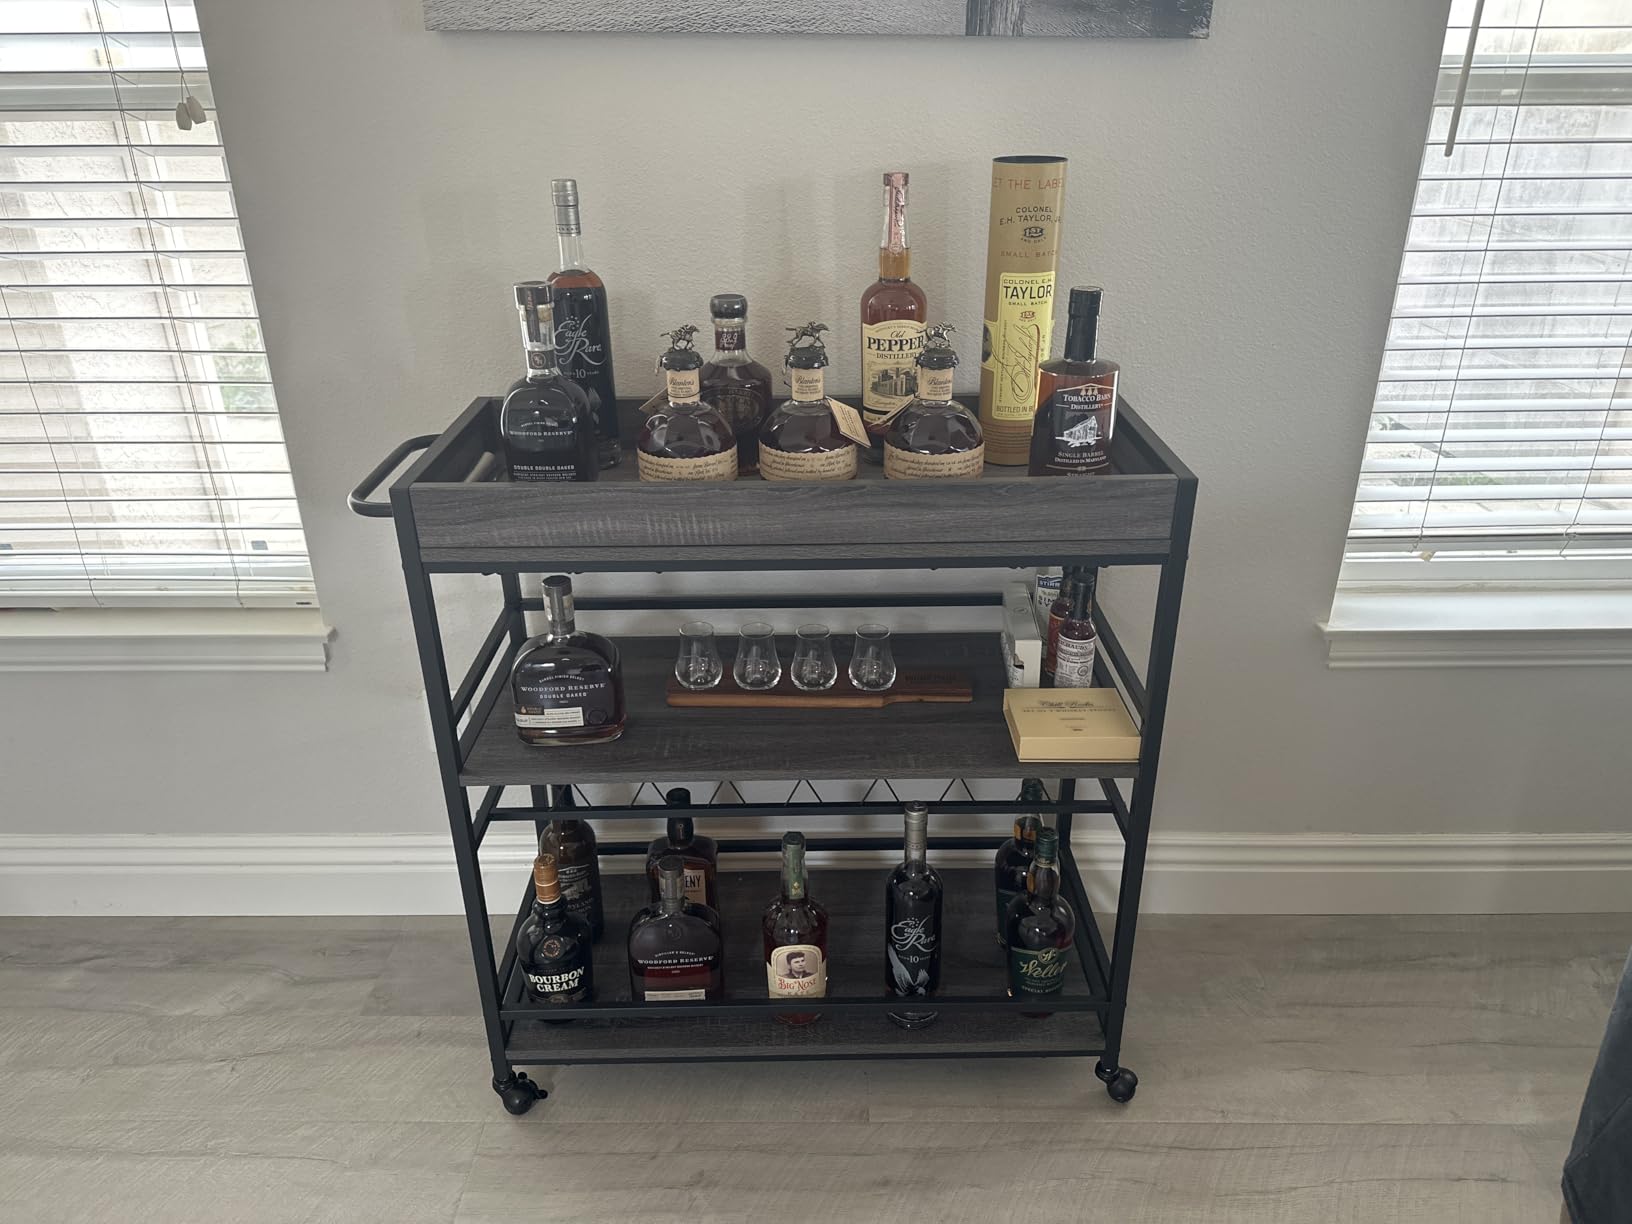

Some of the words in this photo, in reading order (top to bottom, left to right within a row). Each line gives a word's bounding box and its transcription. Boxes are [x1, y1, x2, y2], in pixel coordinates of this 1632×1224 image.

[1007, 178, 1031, 190] THE
[1015, 205, 1053, 214] COLONEL
[1000, 250, 1029, 258] SMALL
[1003, 284, 1052, 299] TAYLOR
[890, 330, 906, 338] Old
[866, 335, 925, 353] PEPPER
[574, 368, 586, 379] 10
[1063, 393, 1096, 402] TOBACCO
[1096, 393, 1112, 402] BARN
[996, 405, 1021, 414] BOTTLED
[567, 682, 606, 691] RESERVE
[891, 915, 931, 942] Eagle
[679, 955, 714, 964] RESERVE
[909, 954, 920, 964] 10
[527, 966, 585, 985] BOURBON
[536, 978, 580, 993] CREAM
[778, 977, 796, 990] BIG
